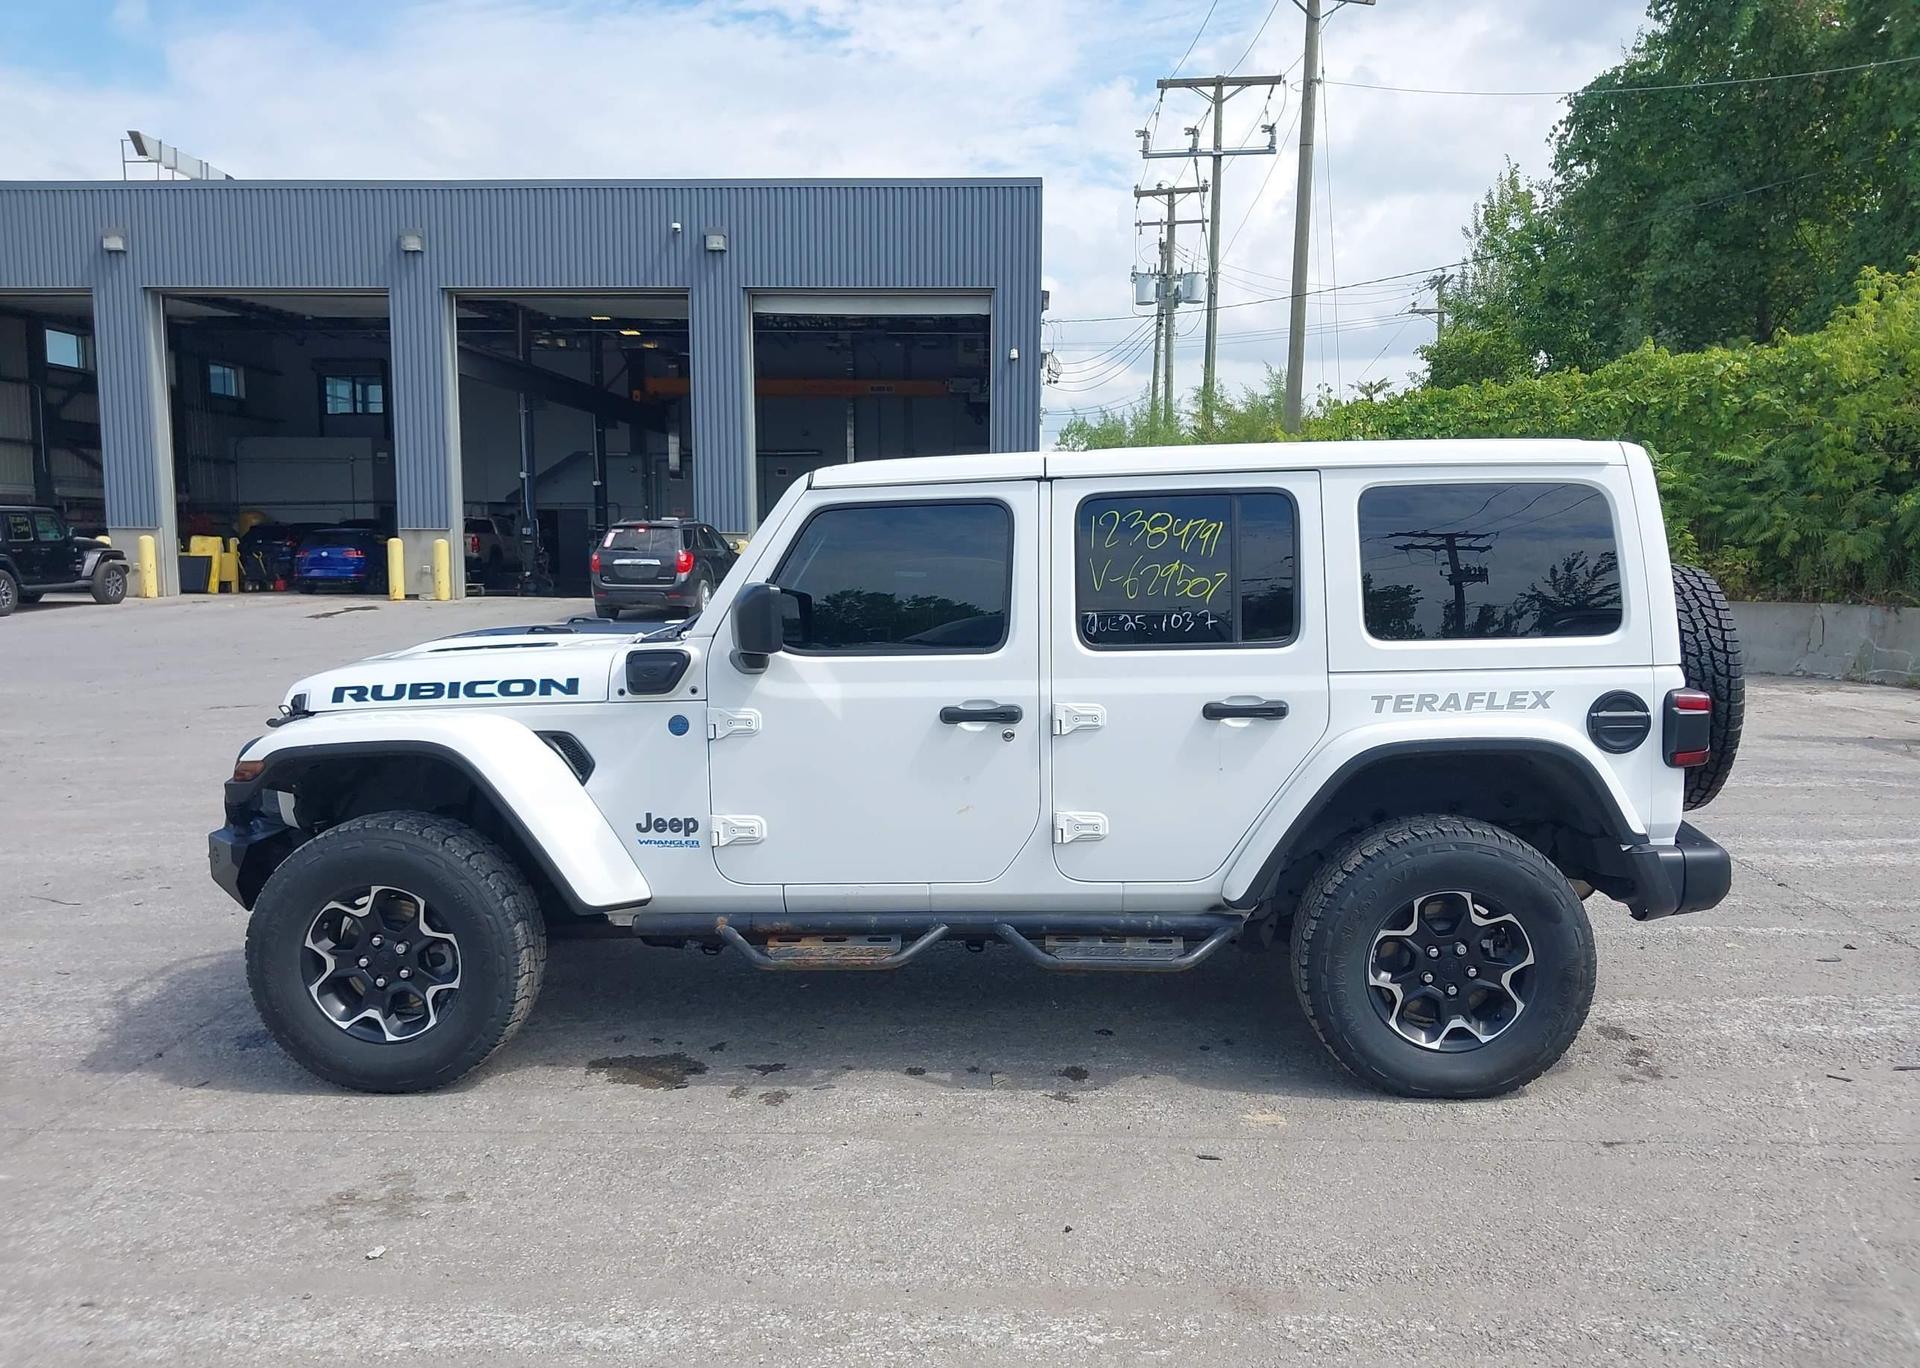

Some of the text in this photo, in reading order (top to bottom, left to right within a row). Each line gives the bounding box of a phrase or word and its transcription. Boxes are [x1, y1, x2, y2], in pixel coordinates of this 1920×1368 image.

[331, 677, 580, 703] RUBICON
[1370, 690, 1556, 714] TERAFLEX
[636, 812, 699, 837] Jeep
